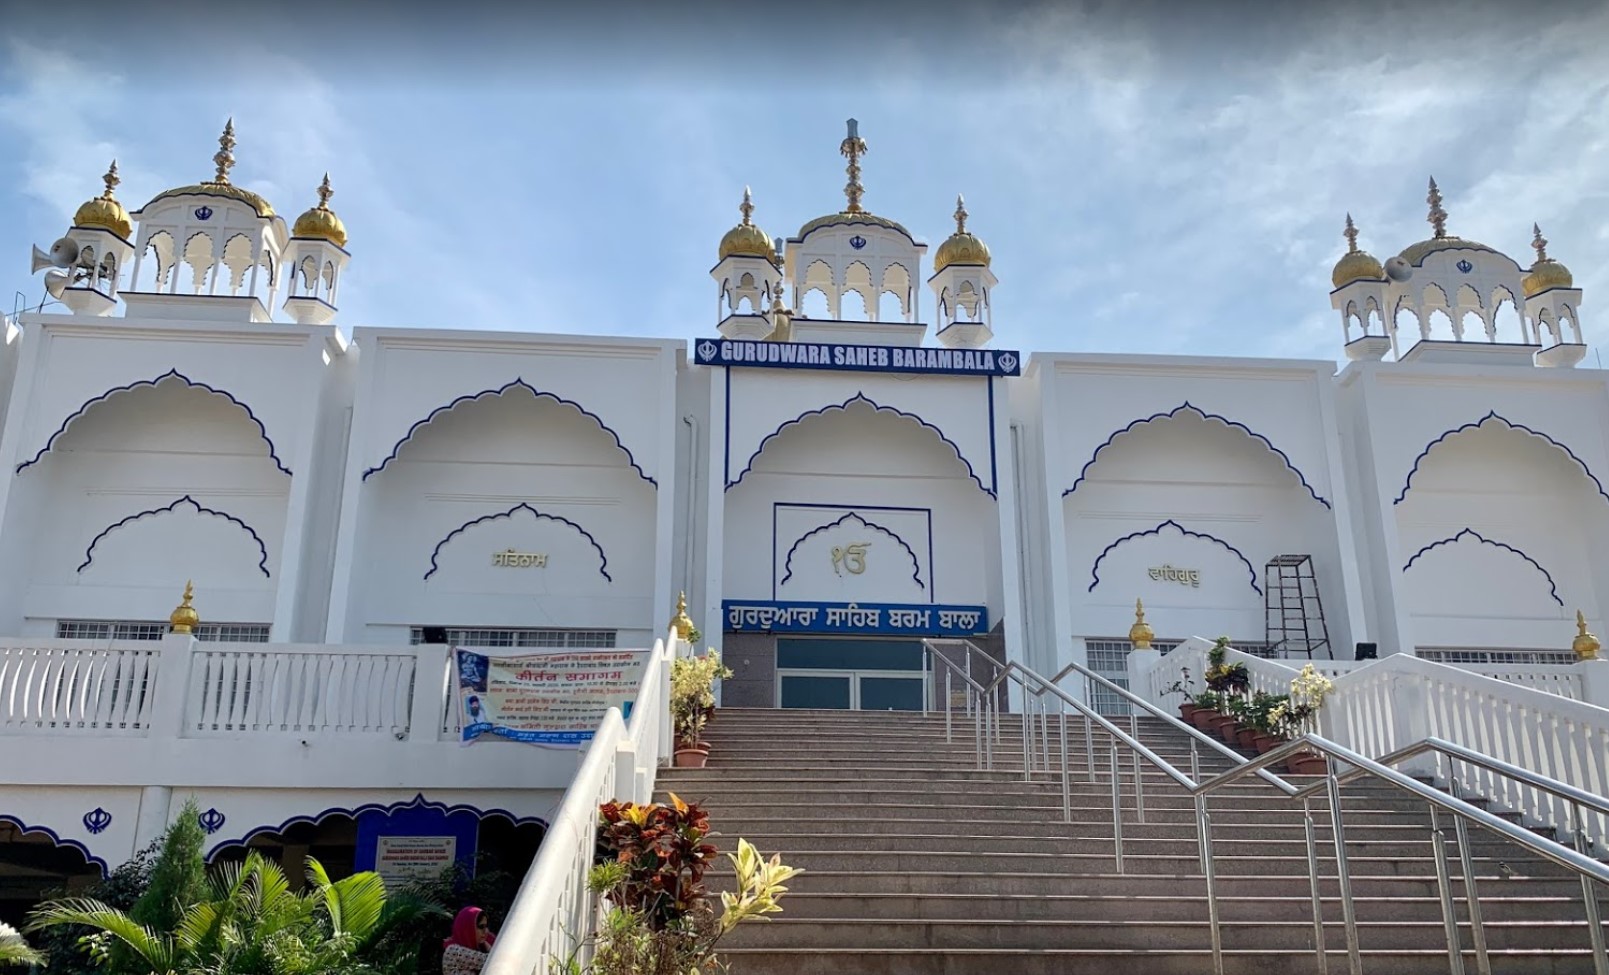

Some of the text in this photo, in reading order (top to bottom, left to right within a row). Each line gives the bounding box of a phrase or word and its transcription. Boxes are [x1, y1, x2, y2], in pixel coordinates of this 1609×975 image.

[720, 341, 995, 370] GURUDWARA SAHEB BARAMBALA
[492, 548, 547, 568] ਸਤਿਨਾਮ
[1148, 564, 1200, 588] ਵਾਹਿਗੁਰੂ
[728, 603, 981, 630] ਗੁਰਦੁਆਰਾ ਸਾਹਿਬ ਬਰਮ ਬਾਲਾ
[515, 670, 624, 682] कीर्तन समागम
